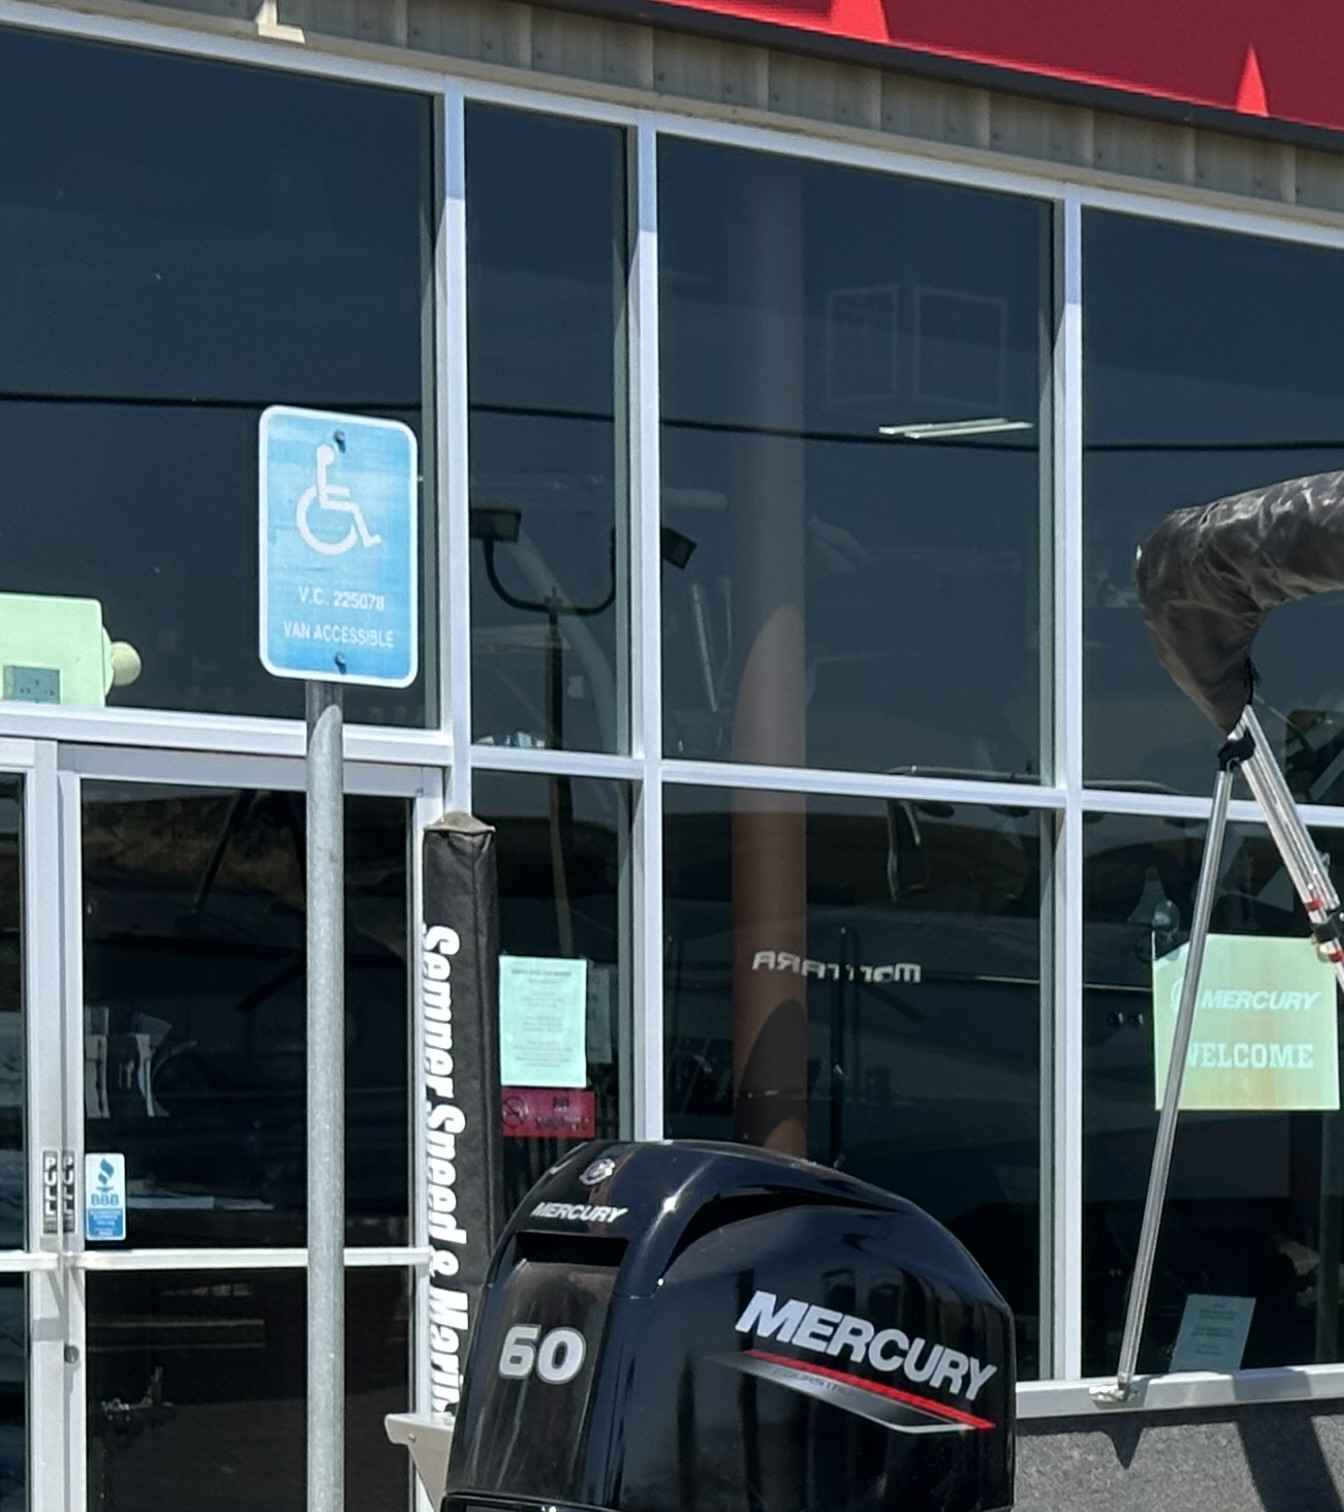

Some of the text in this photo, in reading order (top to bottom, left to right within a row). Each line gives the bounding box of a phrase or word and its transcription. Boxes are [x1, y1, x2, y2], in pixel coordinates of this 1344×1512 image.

[283, 620, 394, 649] VAN ACCESSIBLE
[1200, 988, 1321, 1010] MERCURY
[530, 1202, 629, 1223] MERCURY
[429, 1284, 468, 1413] Marin
[498, 1323, 587, 1385] 60
[735, 1289, 998, 1401] MERCURY
